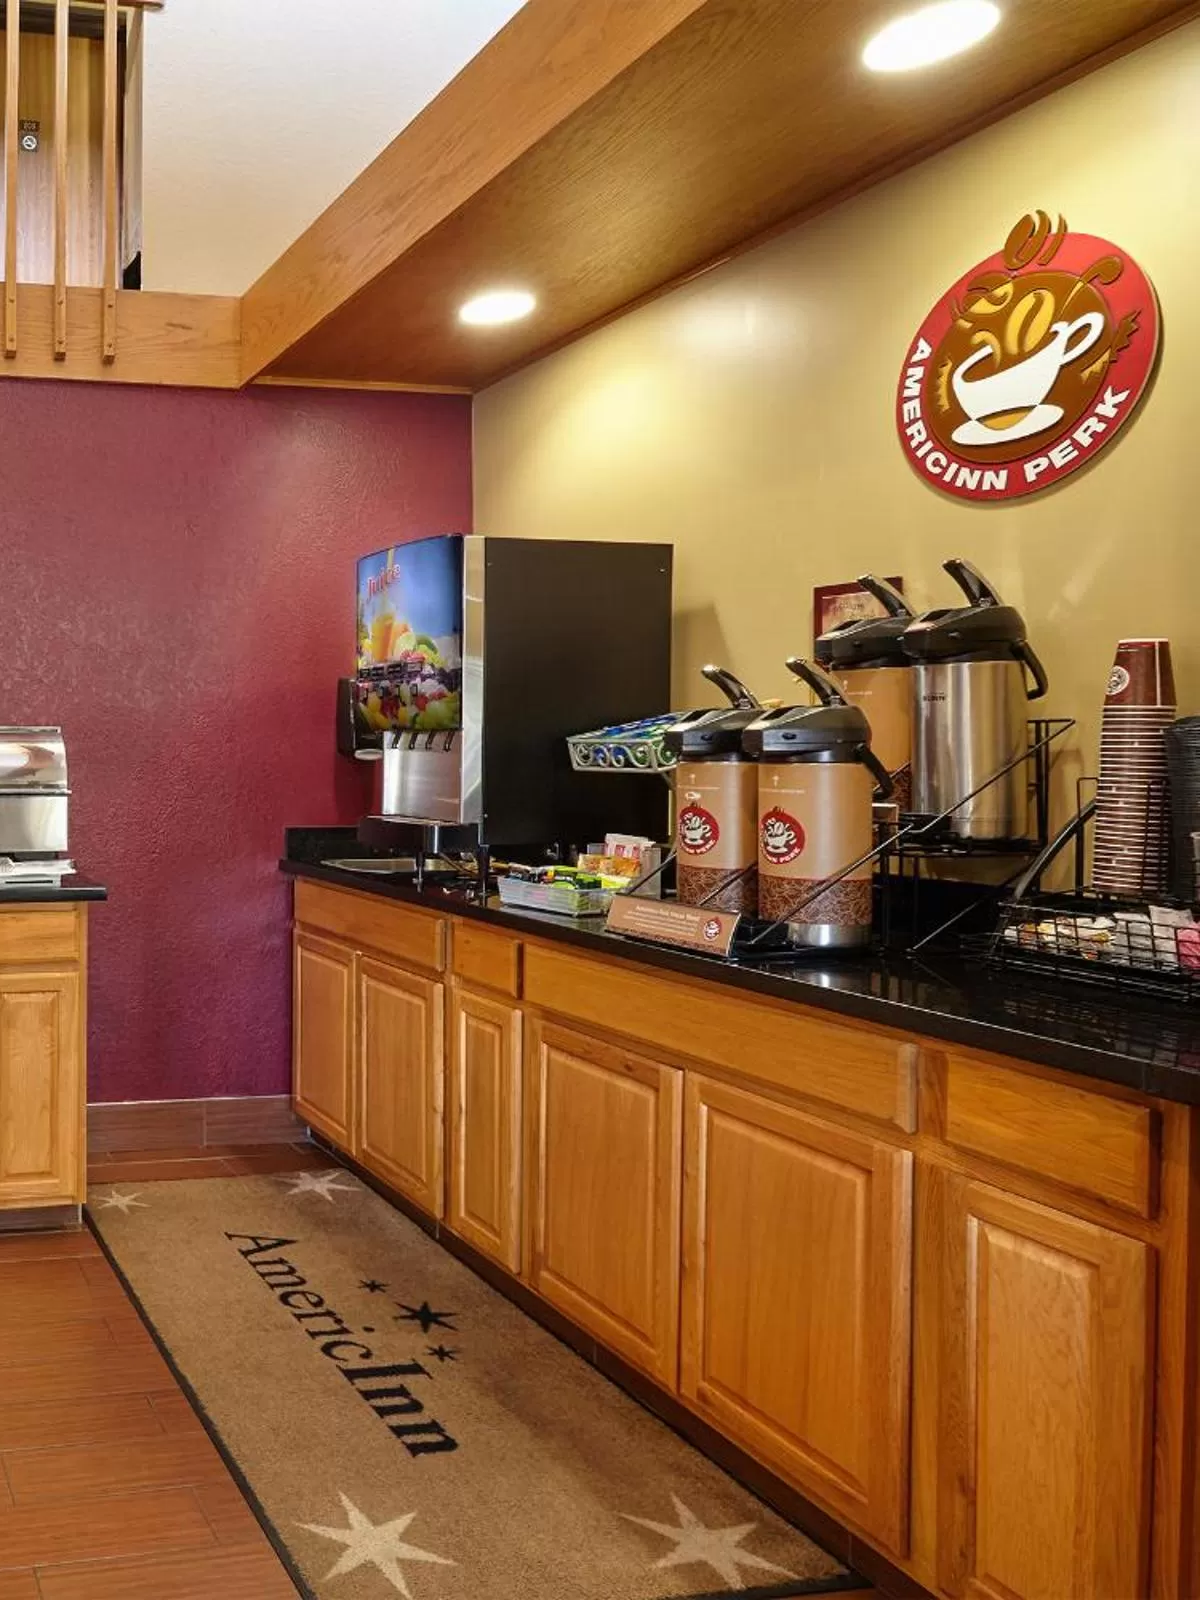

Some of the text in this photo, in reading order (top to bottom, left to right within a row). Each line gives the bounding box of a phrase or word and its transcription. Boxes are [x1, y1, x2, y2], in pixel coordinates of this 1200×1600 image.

[902, 336, 1131, 491] AMERICINN PERK
[367, 563, 401, 600] Juice
[224, 1231, 459, 1458] AmericInn
